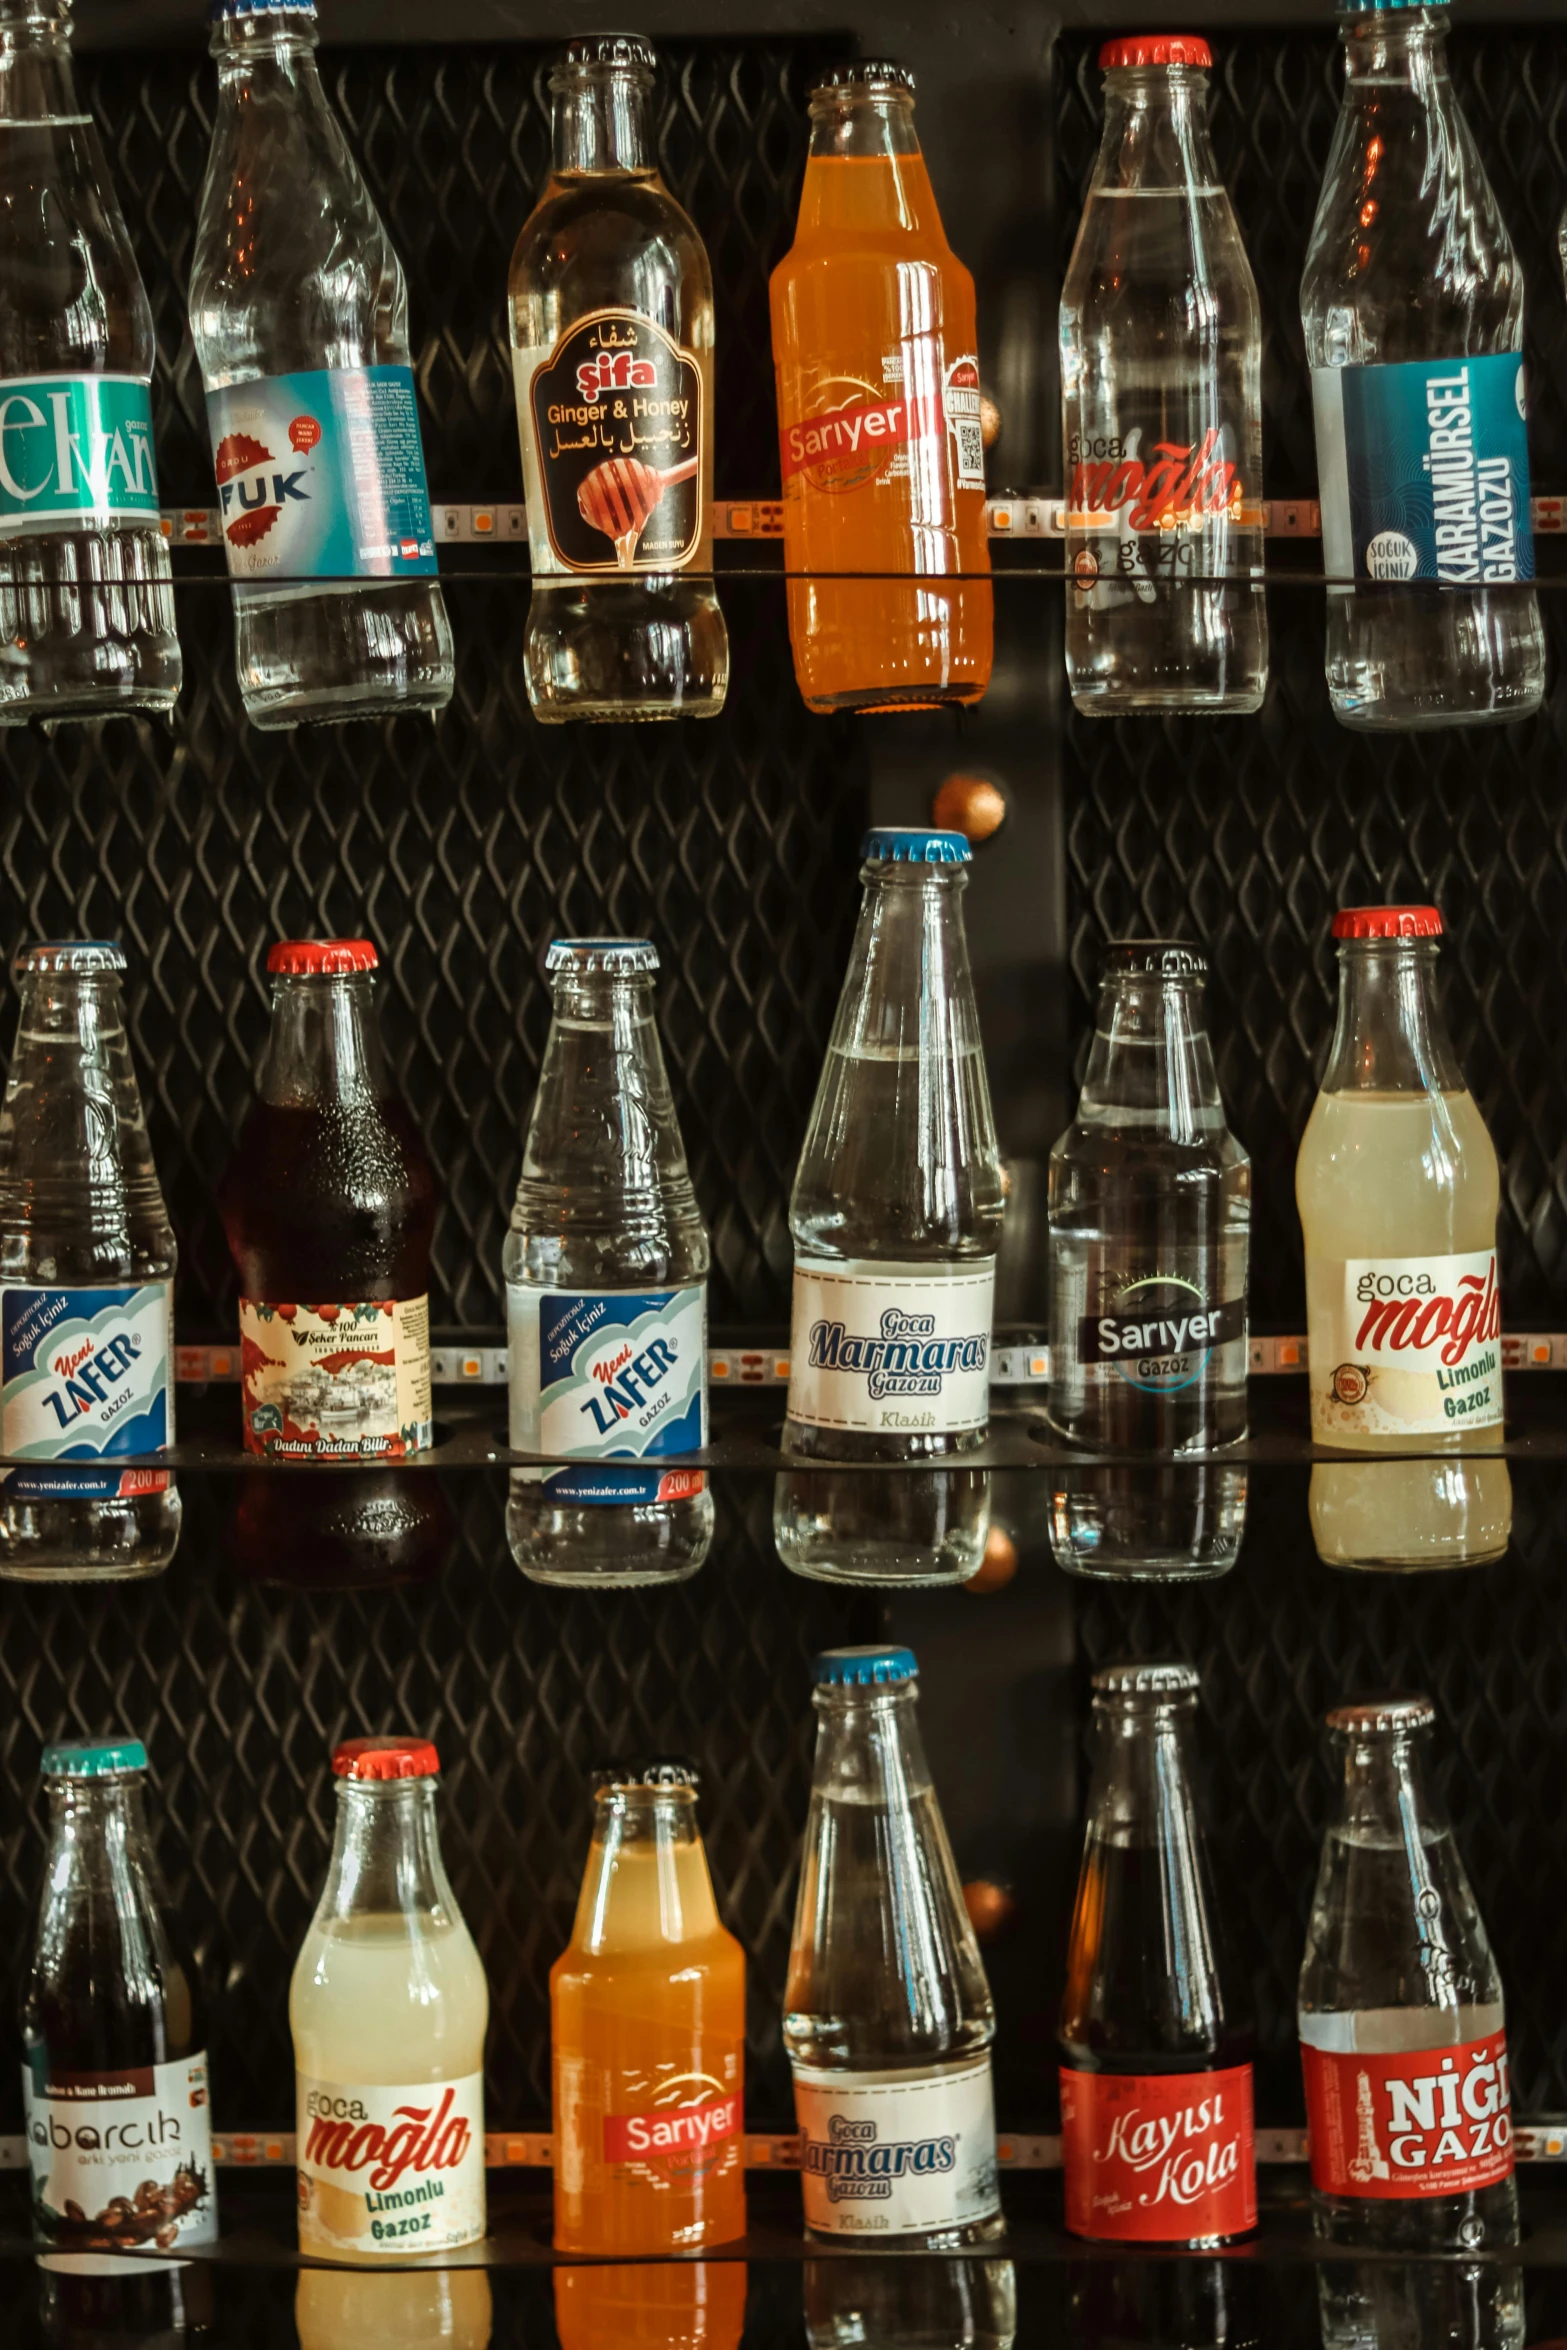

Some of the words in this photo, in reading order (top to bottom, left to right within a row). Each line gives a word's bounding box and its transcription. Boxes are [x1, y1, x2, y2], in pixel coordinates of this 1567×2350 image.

[589, 325, 638, 348] شفاء
[577, 352, 656, 402] şifa
[548, 405, 607, 426] Ginger
[613, 400, 628, 418] &
[633, 398, 688, 419] Honey
[550, 424, 614, 459] بالعسل
[620, 422, 690, 453] زنجبيل
[789, 406, 902, 462] Sarıyer
[1068, 435, 1126, 465] goca
[221, 456, 248, 469] ORDU
[1423, 366, 1480, 590] KARAMÜRSEL
[218, 471, 312, 515] FUK
[1477, 457, 1516, 583] GAZOZU
[643, 541, 667, 551] MADEN
[669, 540, 685, 549] SUYU
[1370, 541, 1412, 559] SOĞUK
[1356, 1272, 1436, 1302] goca
[12, 1325, 42, 1358] Soğuk
[39, 1296, 69, 1328] İçiniz
[308, 1332, 337, 1346] Şeker
[339, 1331, 378, 1343] Pancarı
[339, 1321, 357, 1332] 100
[549, 1329, 580, 1364] Soğuk
[577, 1302, 607, 1334] İçiniz
[881, 1309, 934, 1340] Goca
[1098, 1310, 1221, 1353] Sarıyer
[54, 1337, 95, 1379] Yeni
[809, 1320, 987, 1374] Marmaras
[592, 1343, 633, 1385] Yeni
[1137, 1357, 1189, 1377] Gazoz
[1436, 1351, 1496, 1391] Limonlu
[41, 1333, 142, 1429] ZAFER
[580, 1338, 679, 1435] ZAFER
[868, 1370, 942, 1400] Gazozu
[100, 1387, 134, 1422] GAZOZ
[639, 1392, 672, 1428] GAZOZ
[1443, 1386, 1491, 1418] Gazoz
[879, 1411, 936, 1428] Klasik
[315, 1437, 359, 1454] Dadan
[17, 1480, 108, 1492] www.yenizafer.com.tr
[128, 1470, 152, 1489] 200
[555, 1485, 646, 1498] www.yenizafer.com.tr
[667, 1474, 690, 1494] 200
[306, 2090, 368, 2120] goca
[27, 2109, 181, 2150] abarcık
[627, 2102, 734, 2150] Sarıyer
[828, 2115, 876, 2142] Goca
[1093, 2094, 1224, 2173] Kayısı
[1389, 2114, 1511, 2168] GAZO
[801, 2127, 956, 2177] armaras
[826, 2174, 892, 2202] Gazozu
[1139, 2142, 1239, 2206] Kola
[365, 2180, 445, 2213] Limonlu
[370, 2212, 432, 2240] Gazoz
[838, 2214, 890, 2230] Klasik
